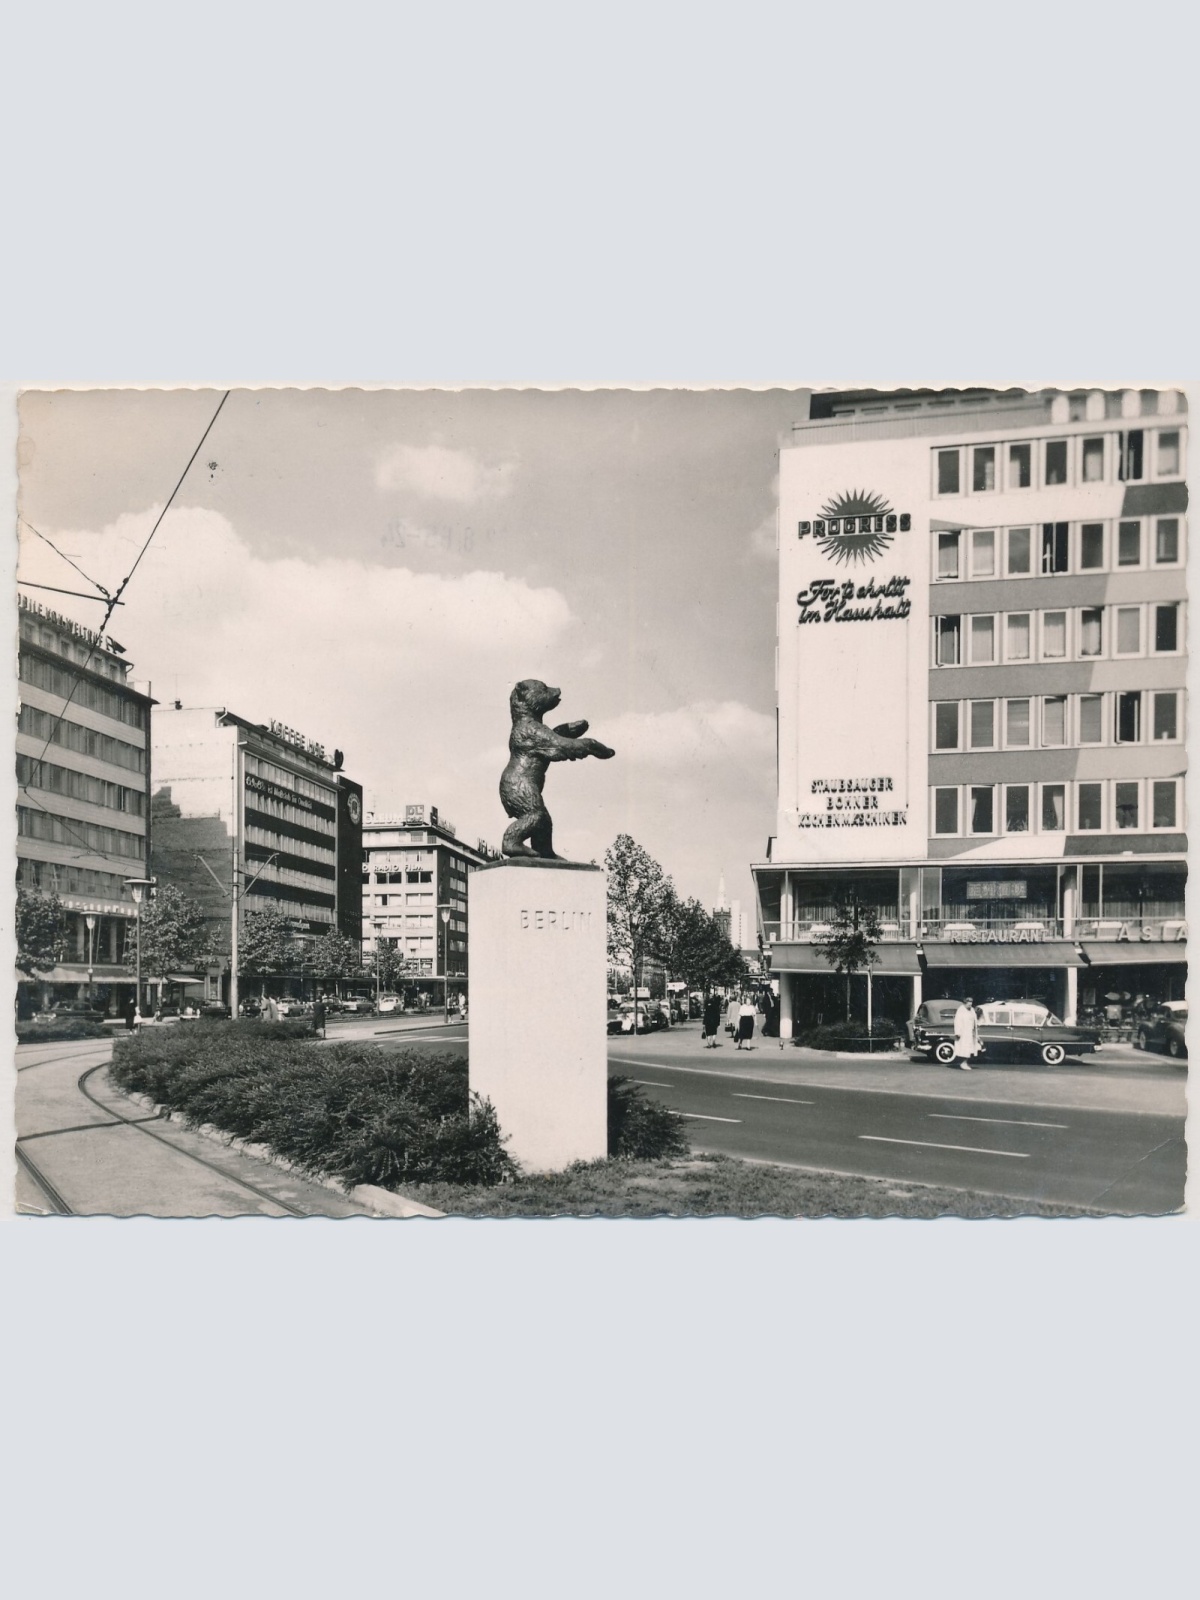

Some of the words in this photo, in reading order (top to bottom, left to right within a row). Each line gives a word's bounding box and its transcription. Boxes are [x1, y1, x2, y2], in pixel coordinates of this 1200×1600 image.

[798, 513, 911, 539] PROGRESS
[797, 576, 911, 606] Fortschritt
[799, 605, 822, 624] im
[824, 598, 911, 622] Haushalt
[269, 718, 306, 751] KAFFEE
[811, 777, 893, 794] STAUBSAUGER
[827, 796, 878, 810] BOHNER
[374, 864, 400, 872] RADIO
[521, 909, 592, 930] BERLIN
[951, 930, 1051, 944] RESTAURANT
[1118, 922, 1188, 942] ASIA
